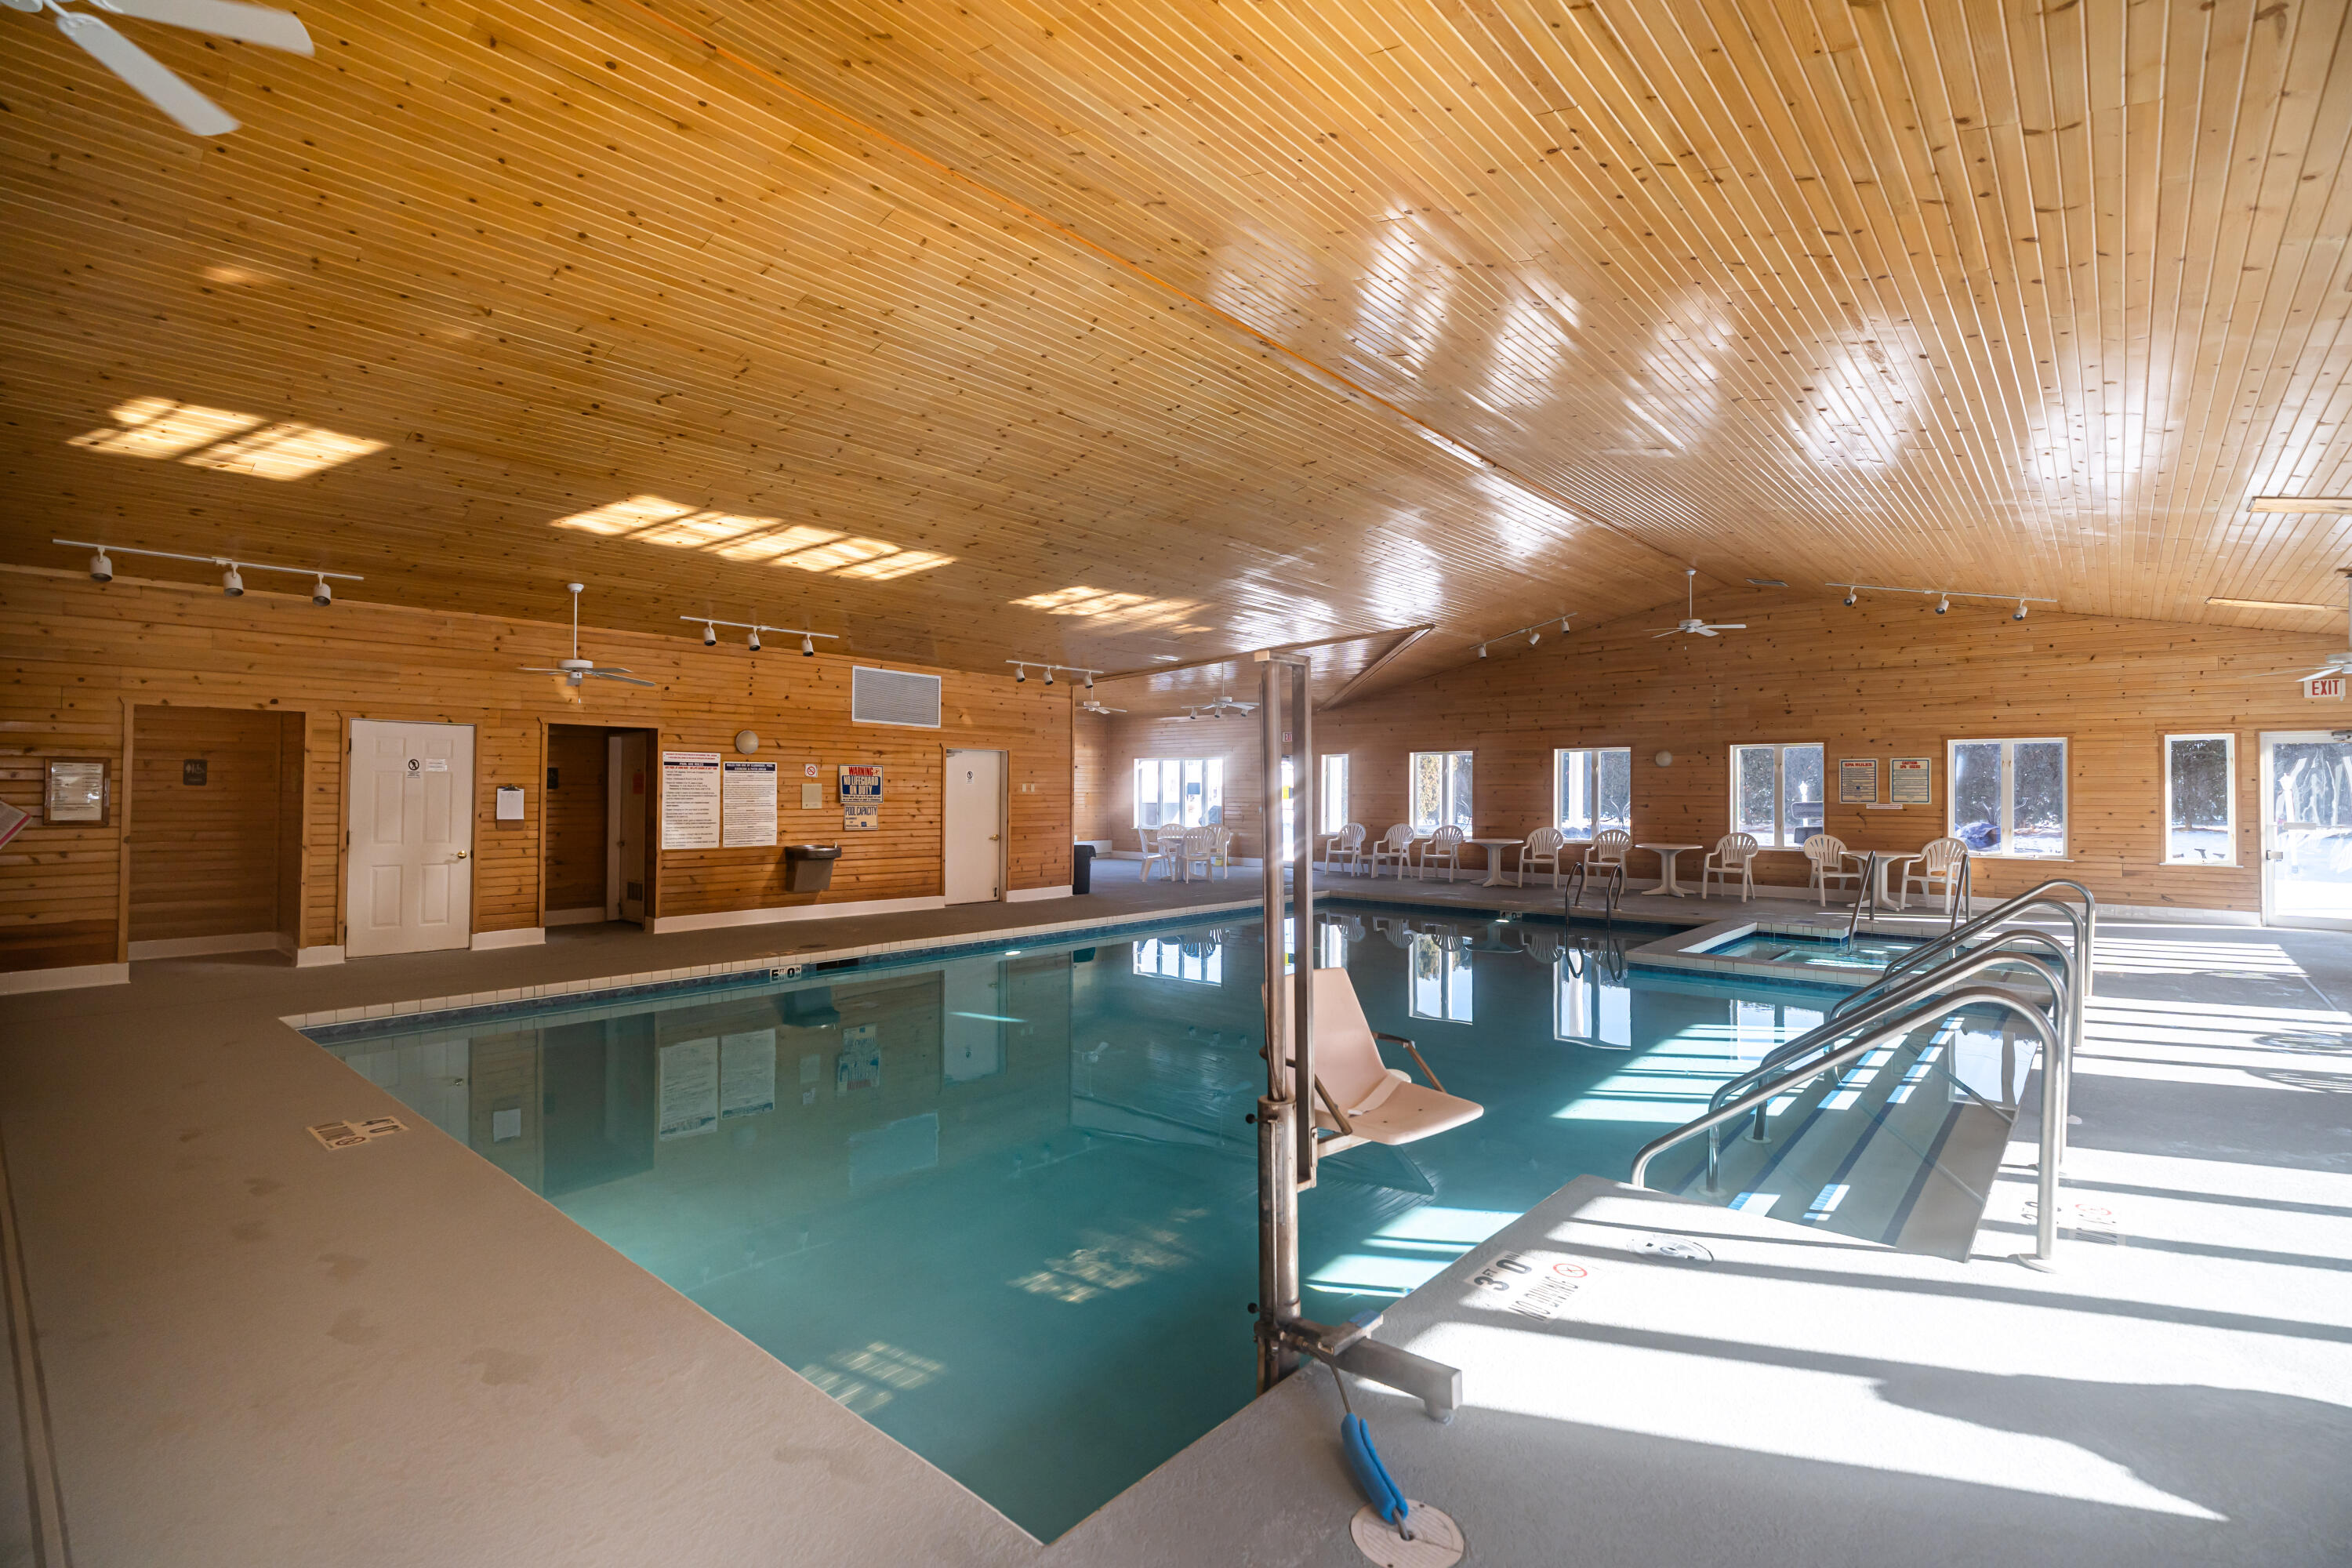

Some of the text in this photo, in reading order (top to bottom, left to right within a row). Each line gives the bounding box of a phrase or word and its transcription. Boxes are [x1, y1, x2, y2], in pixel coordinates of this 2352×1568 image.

[2312, 680, 2339, 695] EXIT
[849, 767, 873, 776] WARNING
[844, 776, 879, 786] NO LIFEGUARD
[849, 785, 872, 795] ON DUTY
[846, 807, 877, 815] POOL CAPACITY
[1474, 1276, 1509, 1290] 3
[1508, 1301, 1551, 1321] NO
